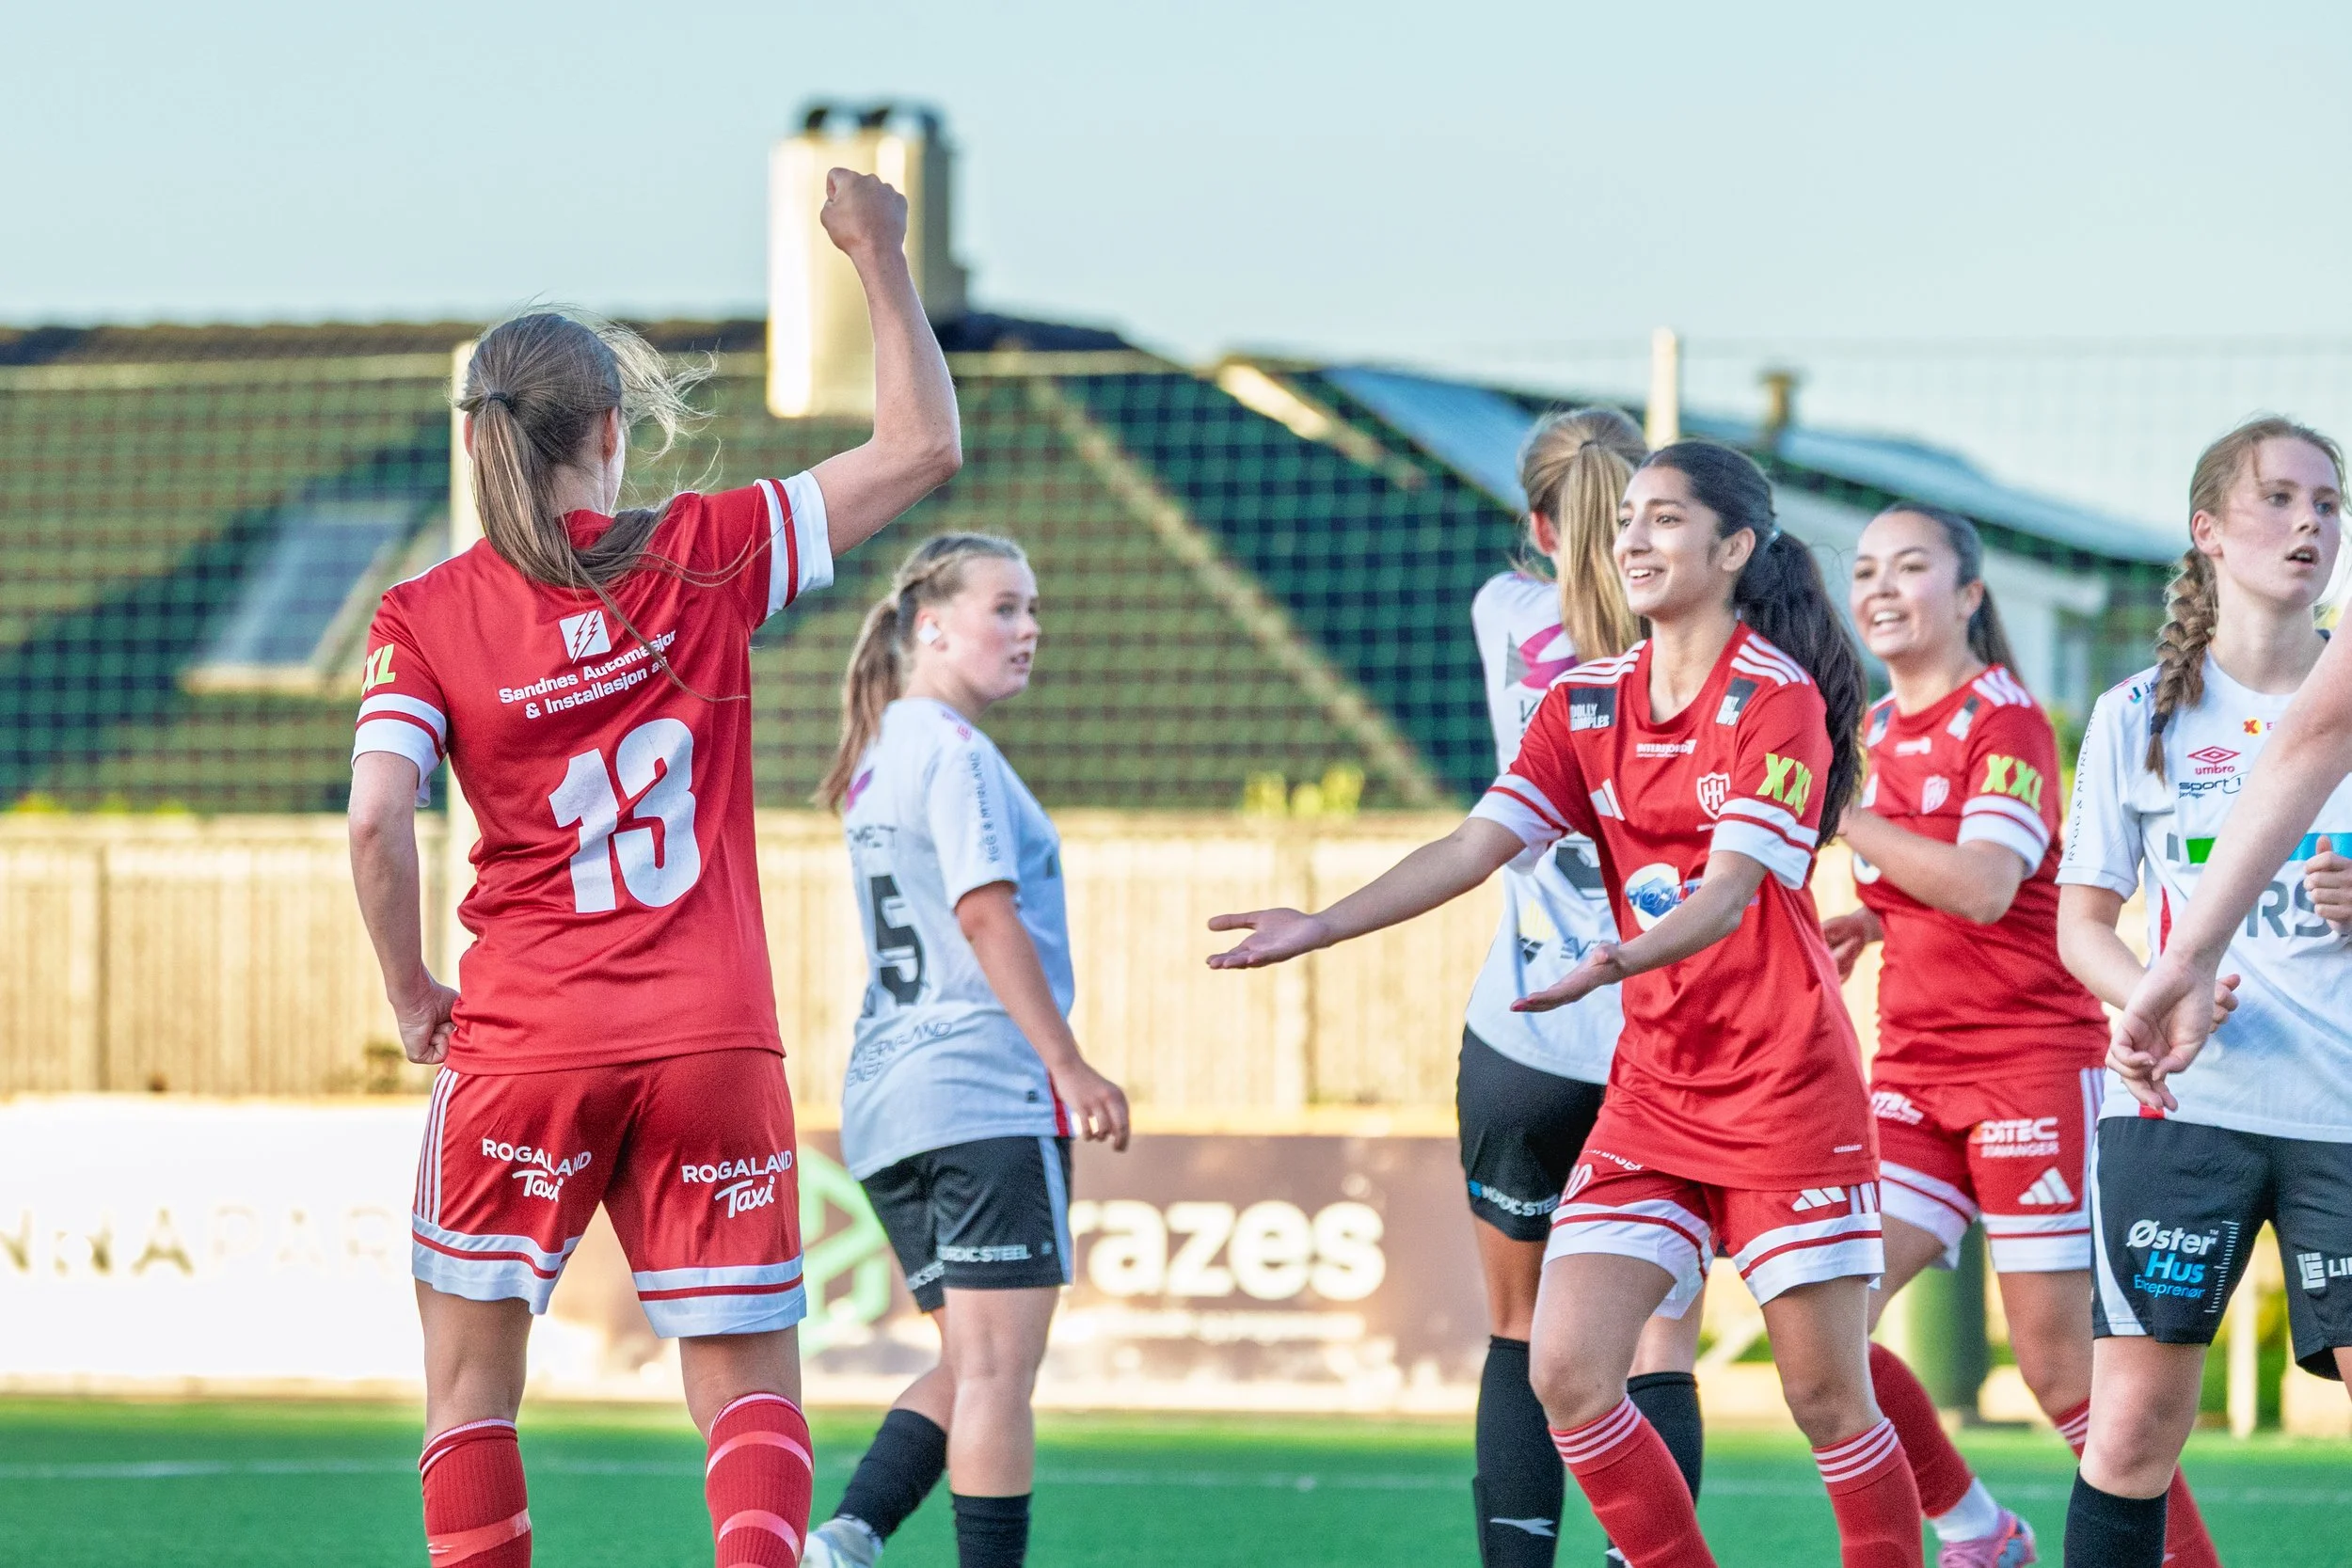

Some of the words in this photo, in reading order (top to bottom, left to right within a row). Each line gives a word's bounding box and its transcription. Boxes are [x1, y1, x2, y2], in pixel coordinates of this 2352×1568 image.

[499, 673, 579, 704] Sandnes
[525, 703, 541, 719] &
[545, 668, 647, 714] Installasjon
[2195, 764, 2235, 775] umbro
[548, 718, 700, 913] 13
[482, 1138, 592, 1178] ROGALAND
[681, 1150, 793, 1183] ROGALAND
[512, 1169, 564, 1203] Taxi
[714, 1176, 775, 1219] Taxi
[2125, 1219, 2217, 1256] Øster
[2145, 1251, 2205, 1284] Hus
